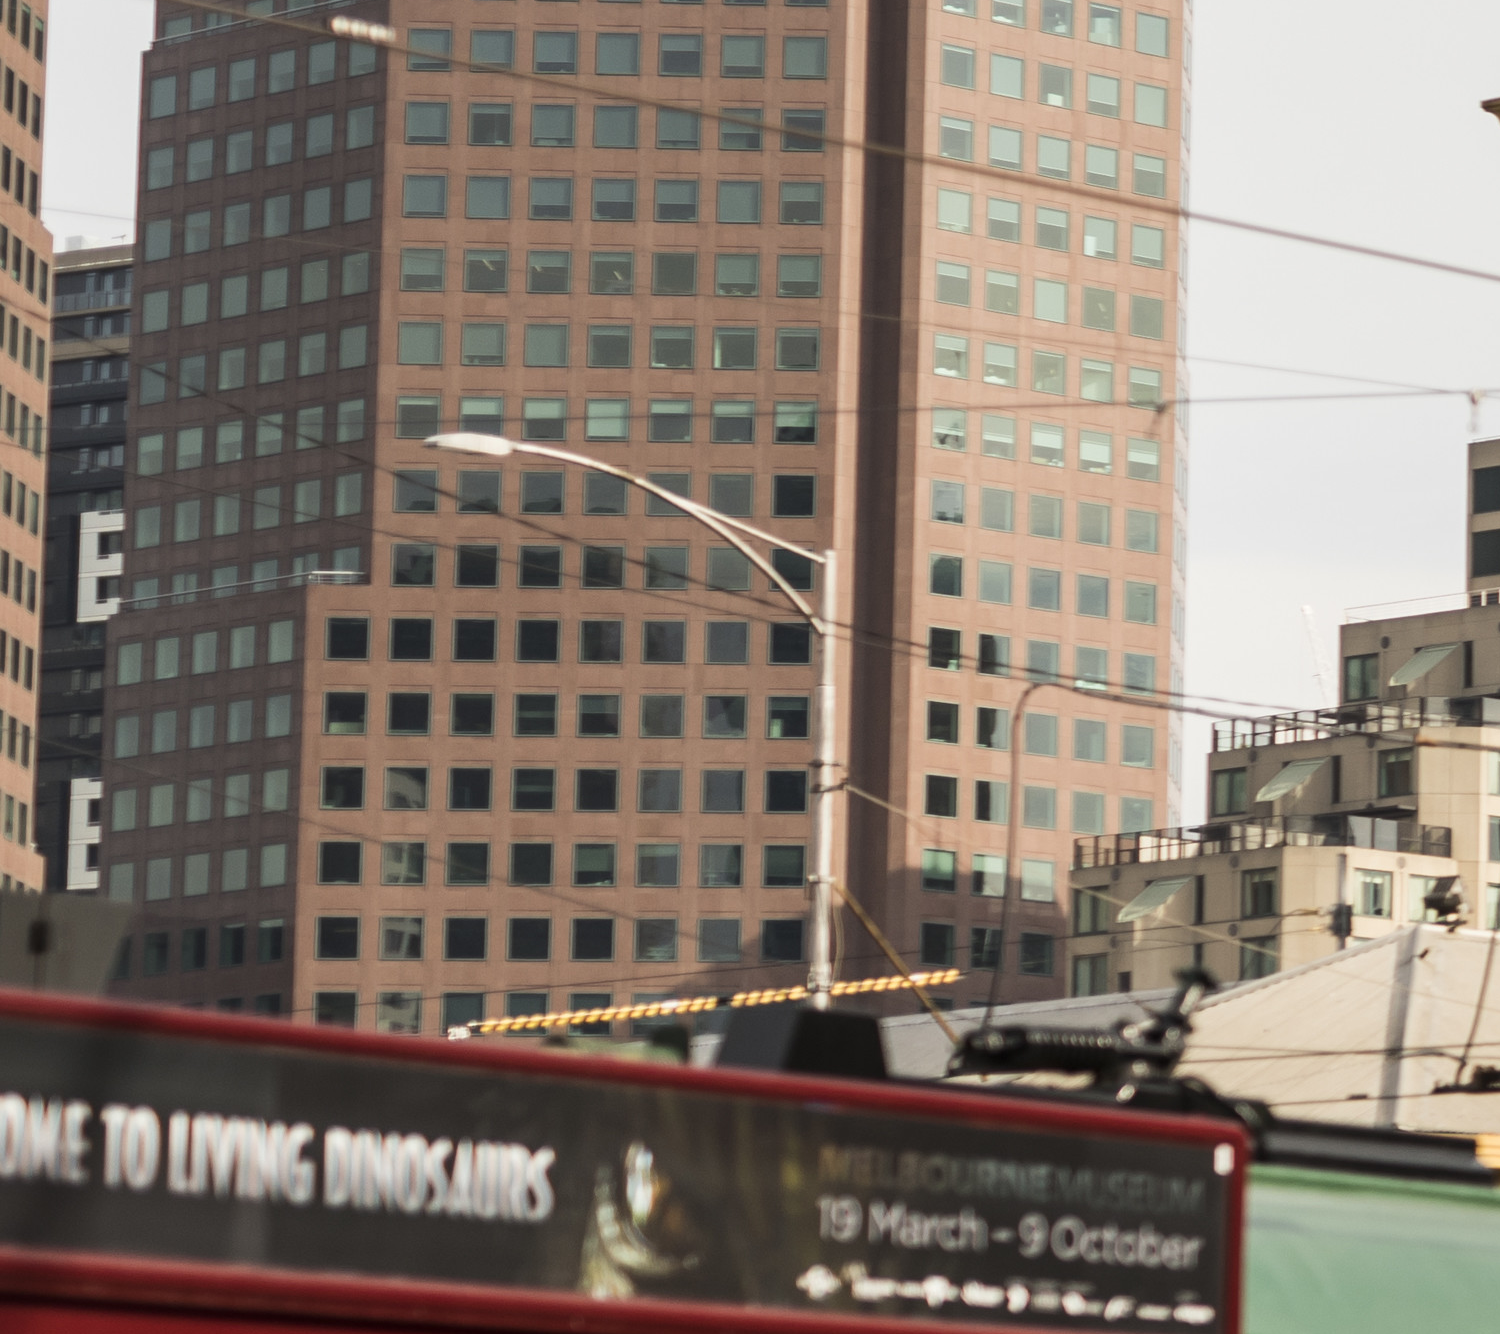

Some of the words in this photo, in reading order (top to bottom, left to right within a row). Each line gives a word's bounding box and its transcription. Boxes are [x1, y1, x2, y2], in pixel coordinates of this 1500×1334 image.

[101, 1103, 160, 1191] TO
[168, 1109, 315, 1205] LIVING
[323, 1125, 557, 1223] DINOSAURS
[818, 1144, 1048, 1202] MELBOURNE
[1055, 1165, 1206, 1214] MUSEUM
[817, 1195, 862, 1242] 19
[868, 1199, 989, 1252] March
[1018, 1212, 1048, 1259] 9
[1050, 1214, 1203, 1270] October
